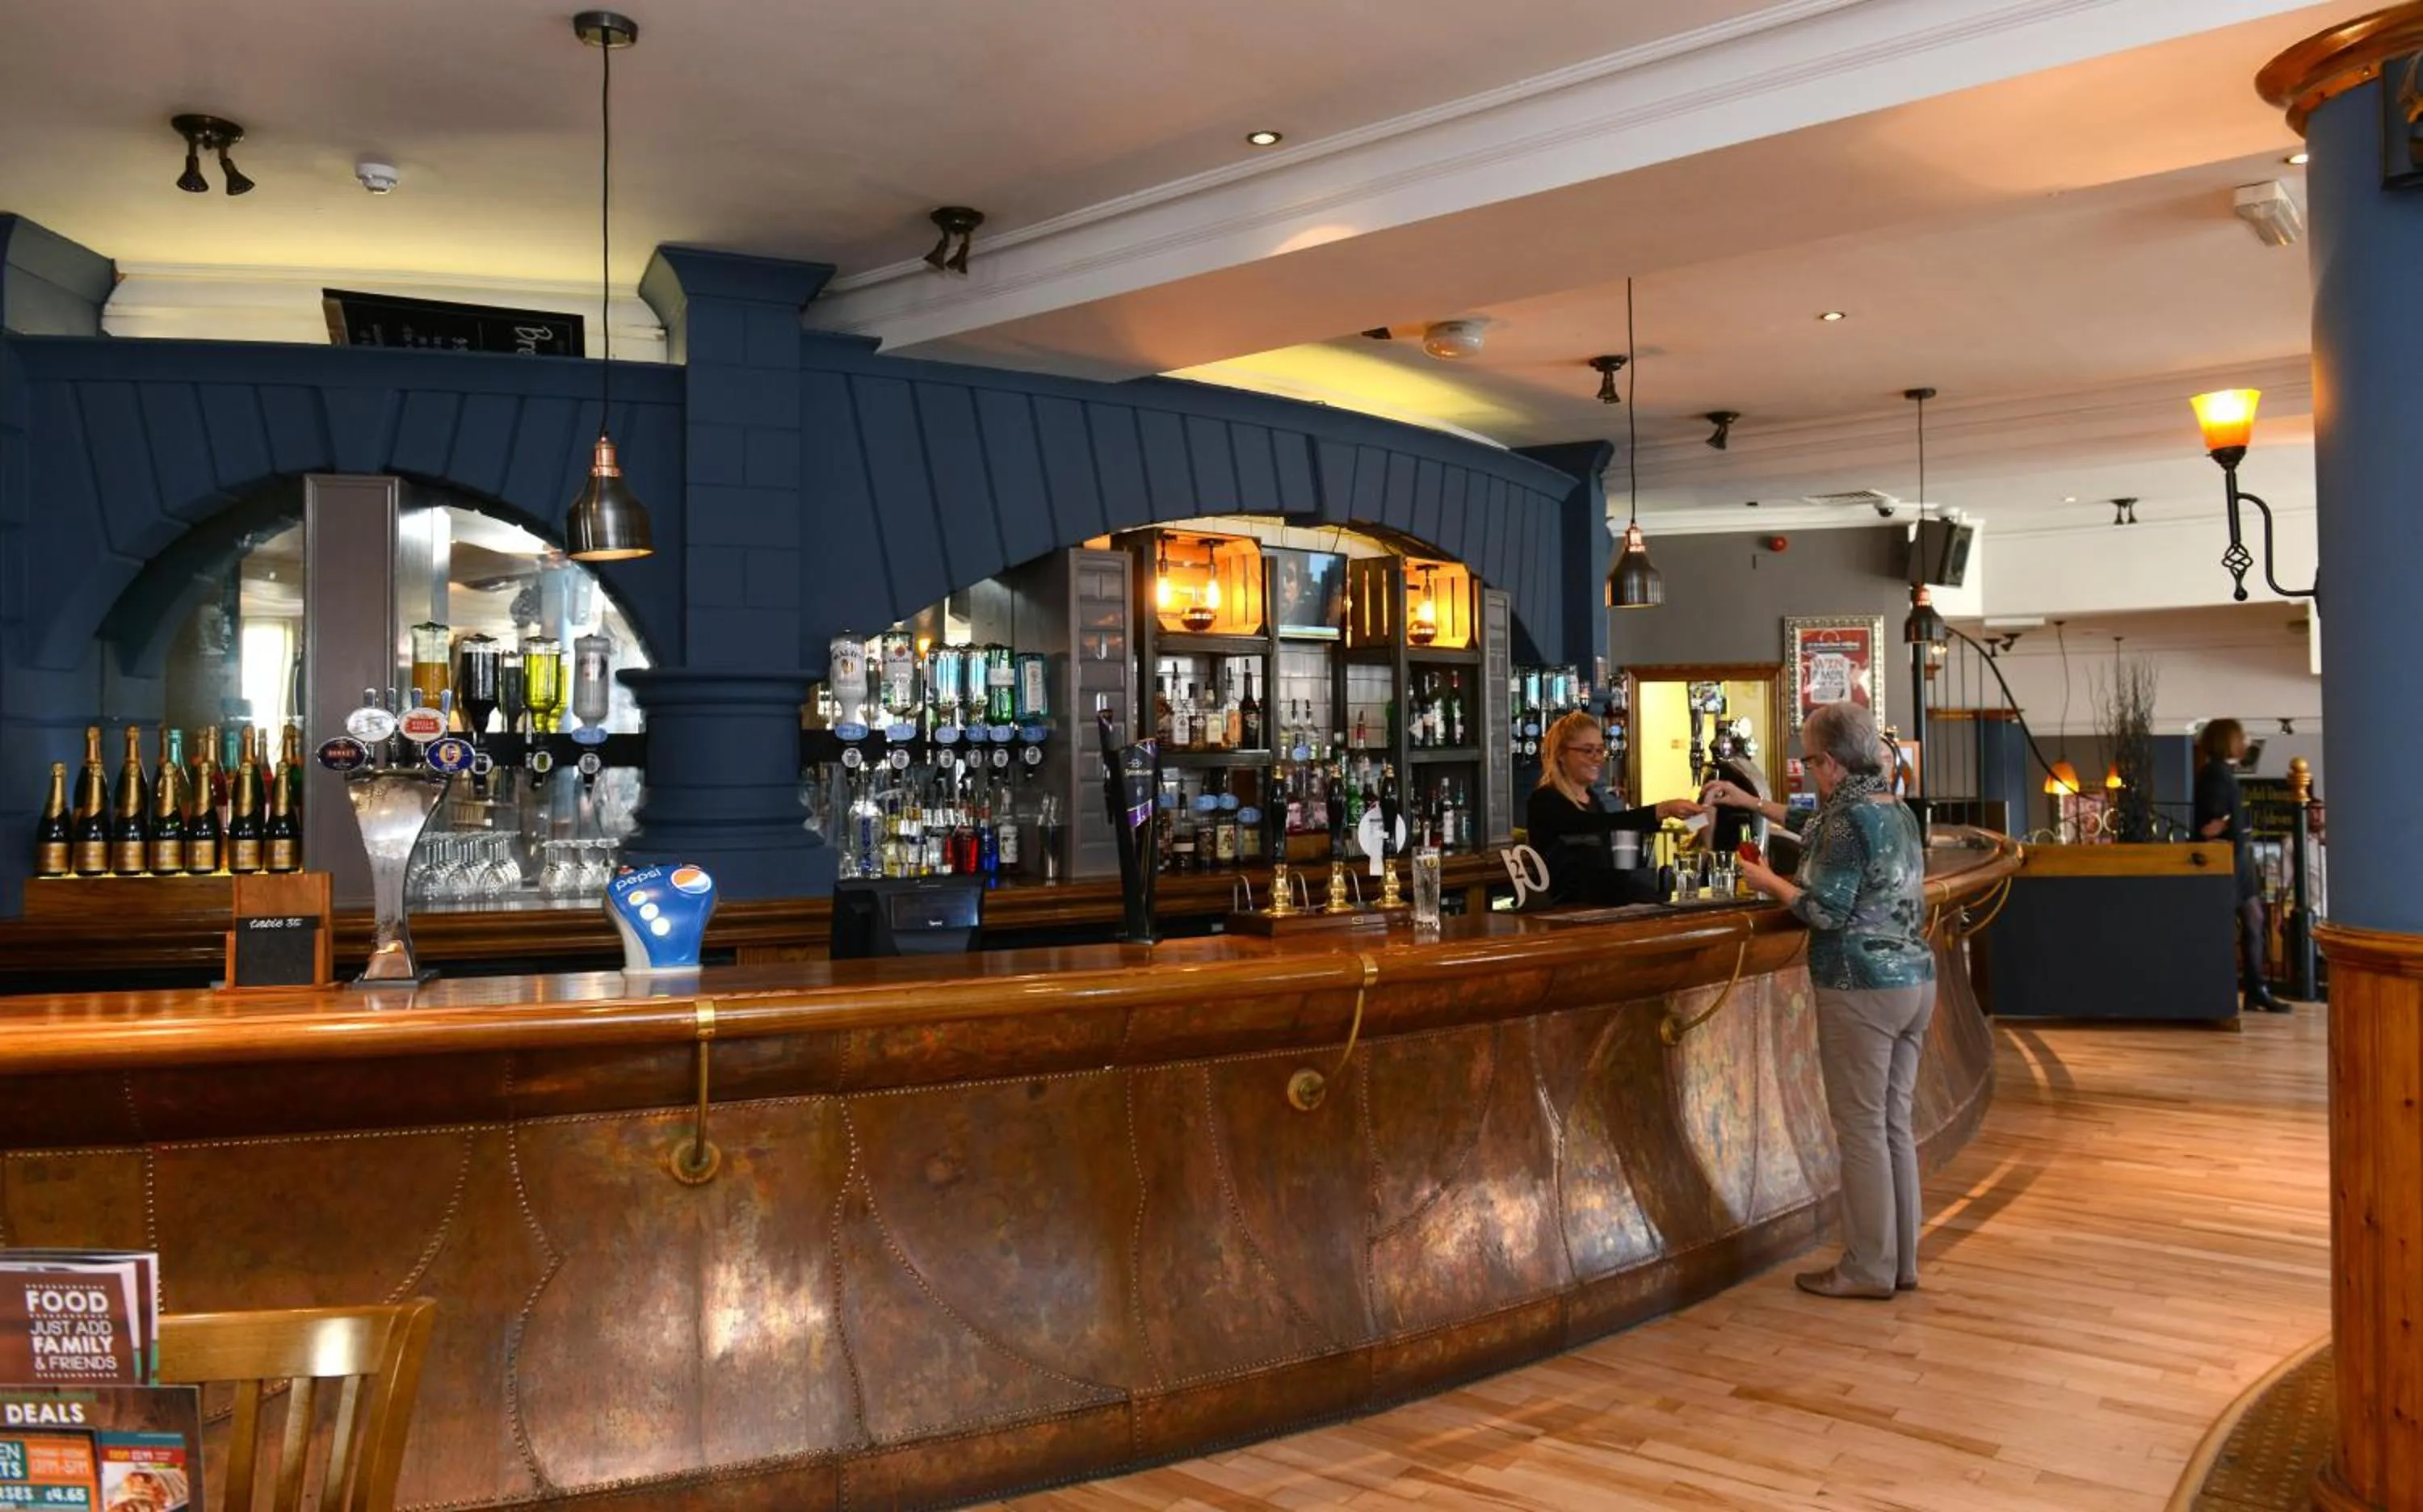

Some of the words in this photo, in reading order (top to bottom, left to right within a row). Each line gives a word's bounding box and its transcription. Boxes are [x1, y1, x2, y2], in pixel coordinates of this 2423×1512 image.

[615, 868, 662, 892] pepsi
[25, 1290, 110, 1312] FOOD
[30, 1321, 71, 1336] JUST
[76, 1321, 113, 1336] ADD
[32, 1336, 115, 1354] FAMILY
[34, 1356, 45, 1371] &
[49, 1355, 118, 1371] FRIENDS
[5, 1402, 86, 1424] DEALS
[0, 1461, 23, 1479] TS
